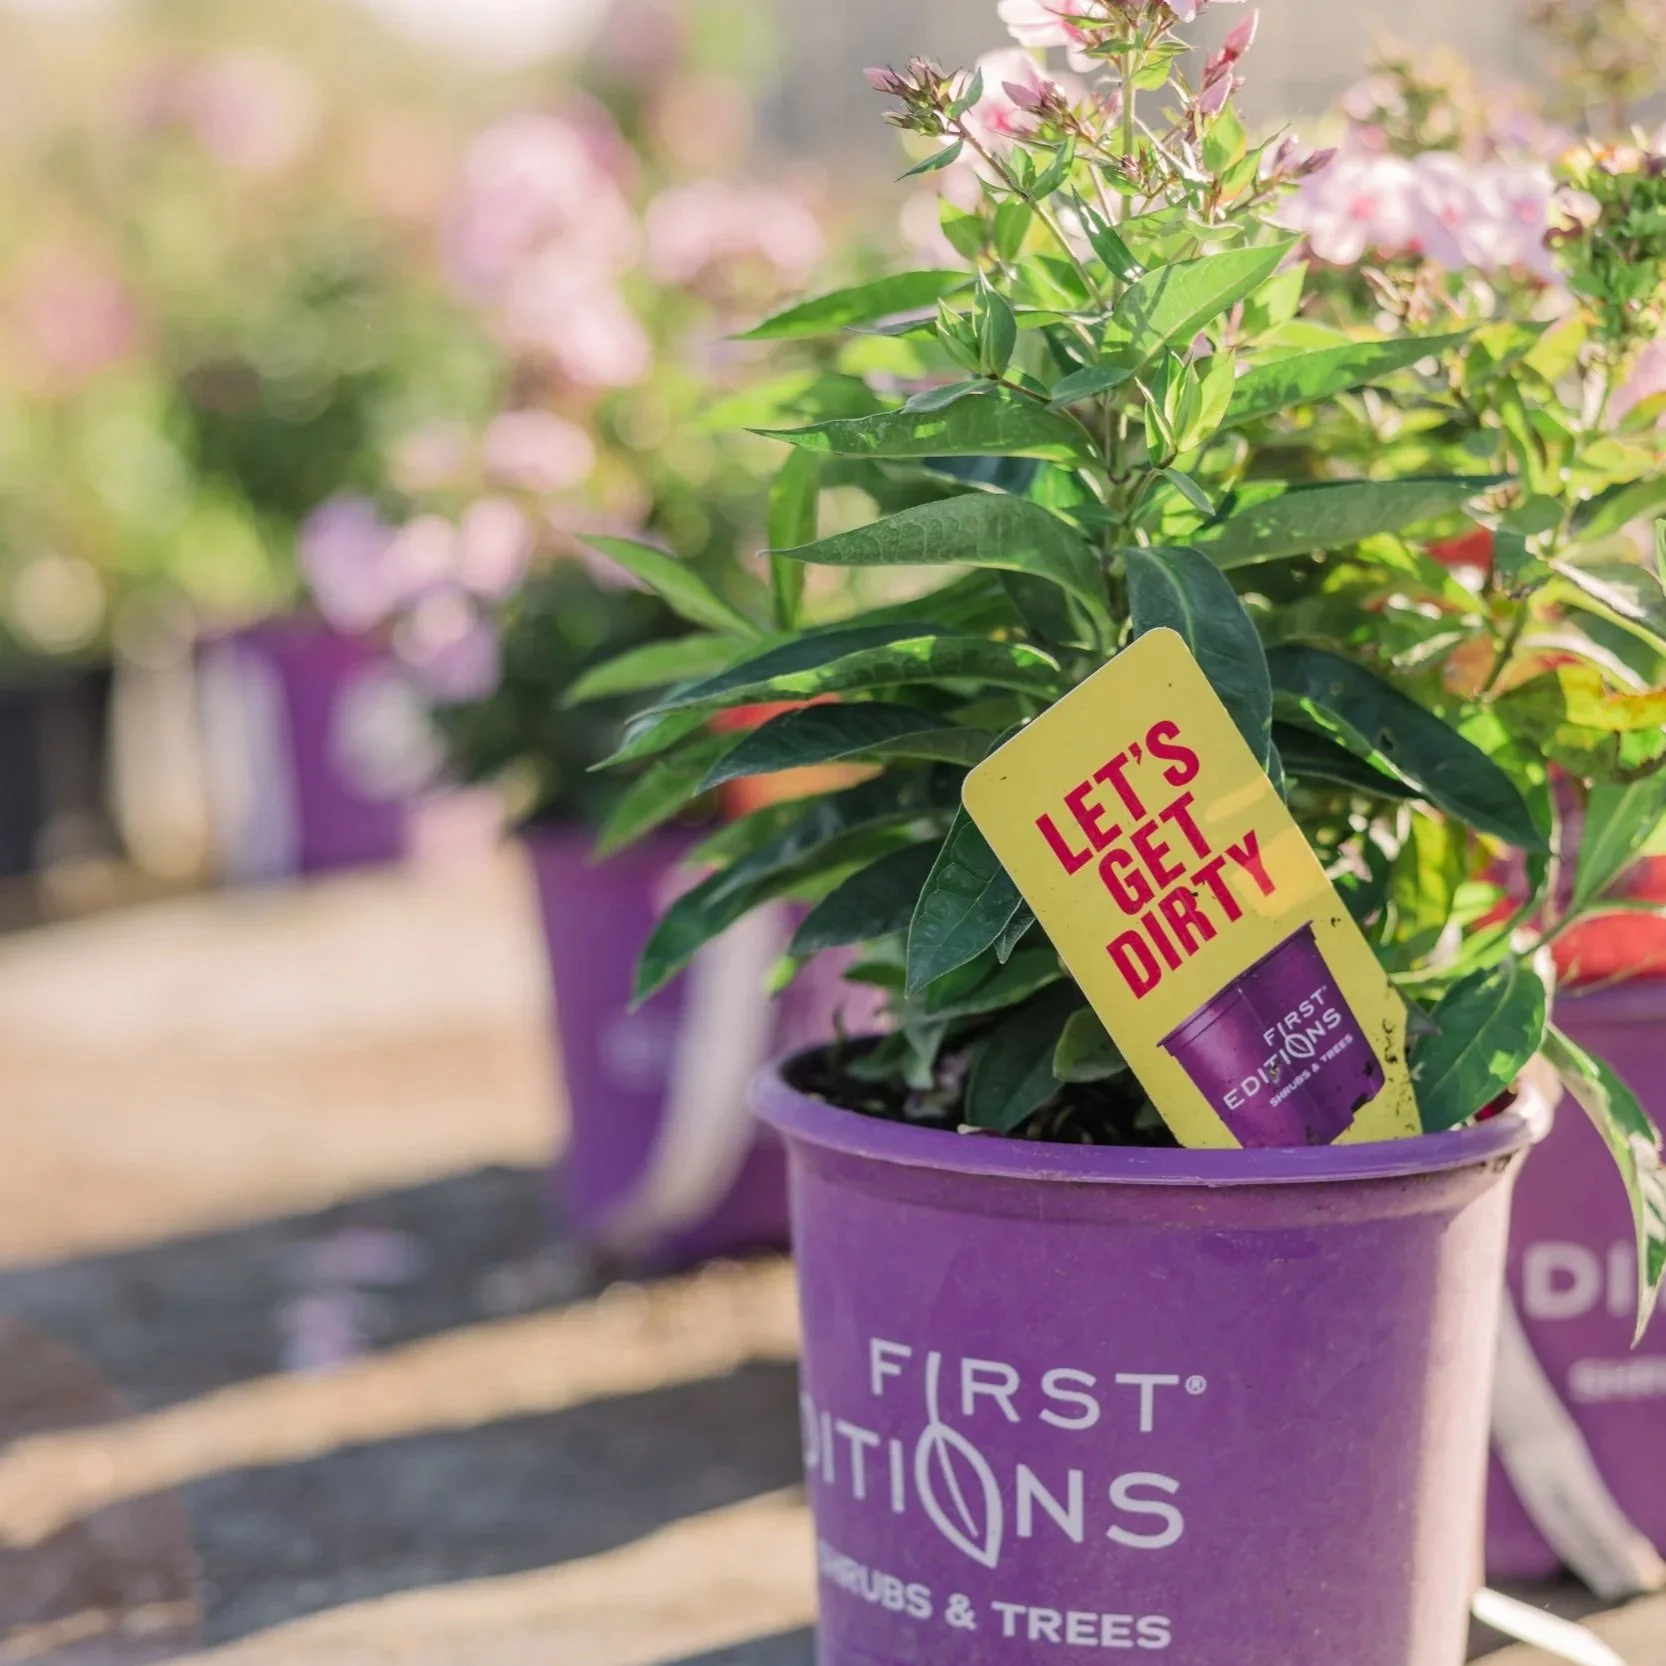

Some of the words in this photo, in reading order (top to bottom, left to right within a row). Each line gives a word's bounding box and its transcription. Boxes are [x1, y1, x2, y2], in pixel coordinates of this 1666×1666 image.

[1035, 719, 1200, 876] LET'S
[1098, 791, 1212, 915] GET
[1105, 829, 1277, 1000] DIRTY
[1222, 1007, 1342, 1111] EDITIONS
[1269, 1069, 1312, 1108] SHRUBS
[1319, 1033, 1354, 1062] TREES
[944, 1592, 977, 1631] &
[990, 1600, 1173, 1650] TREES
